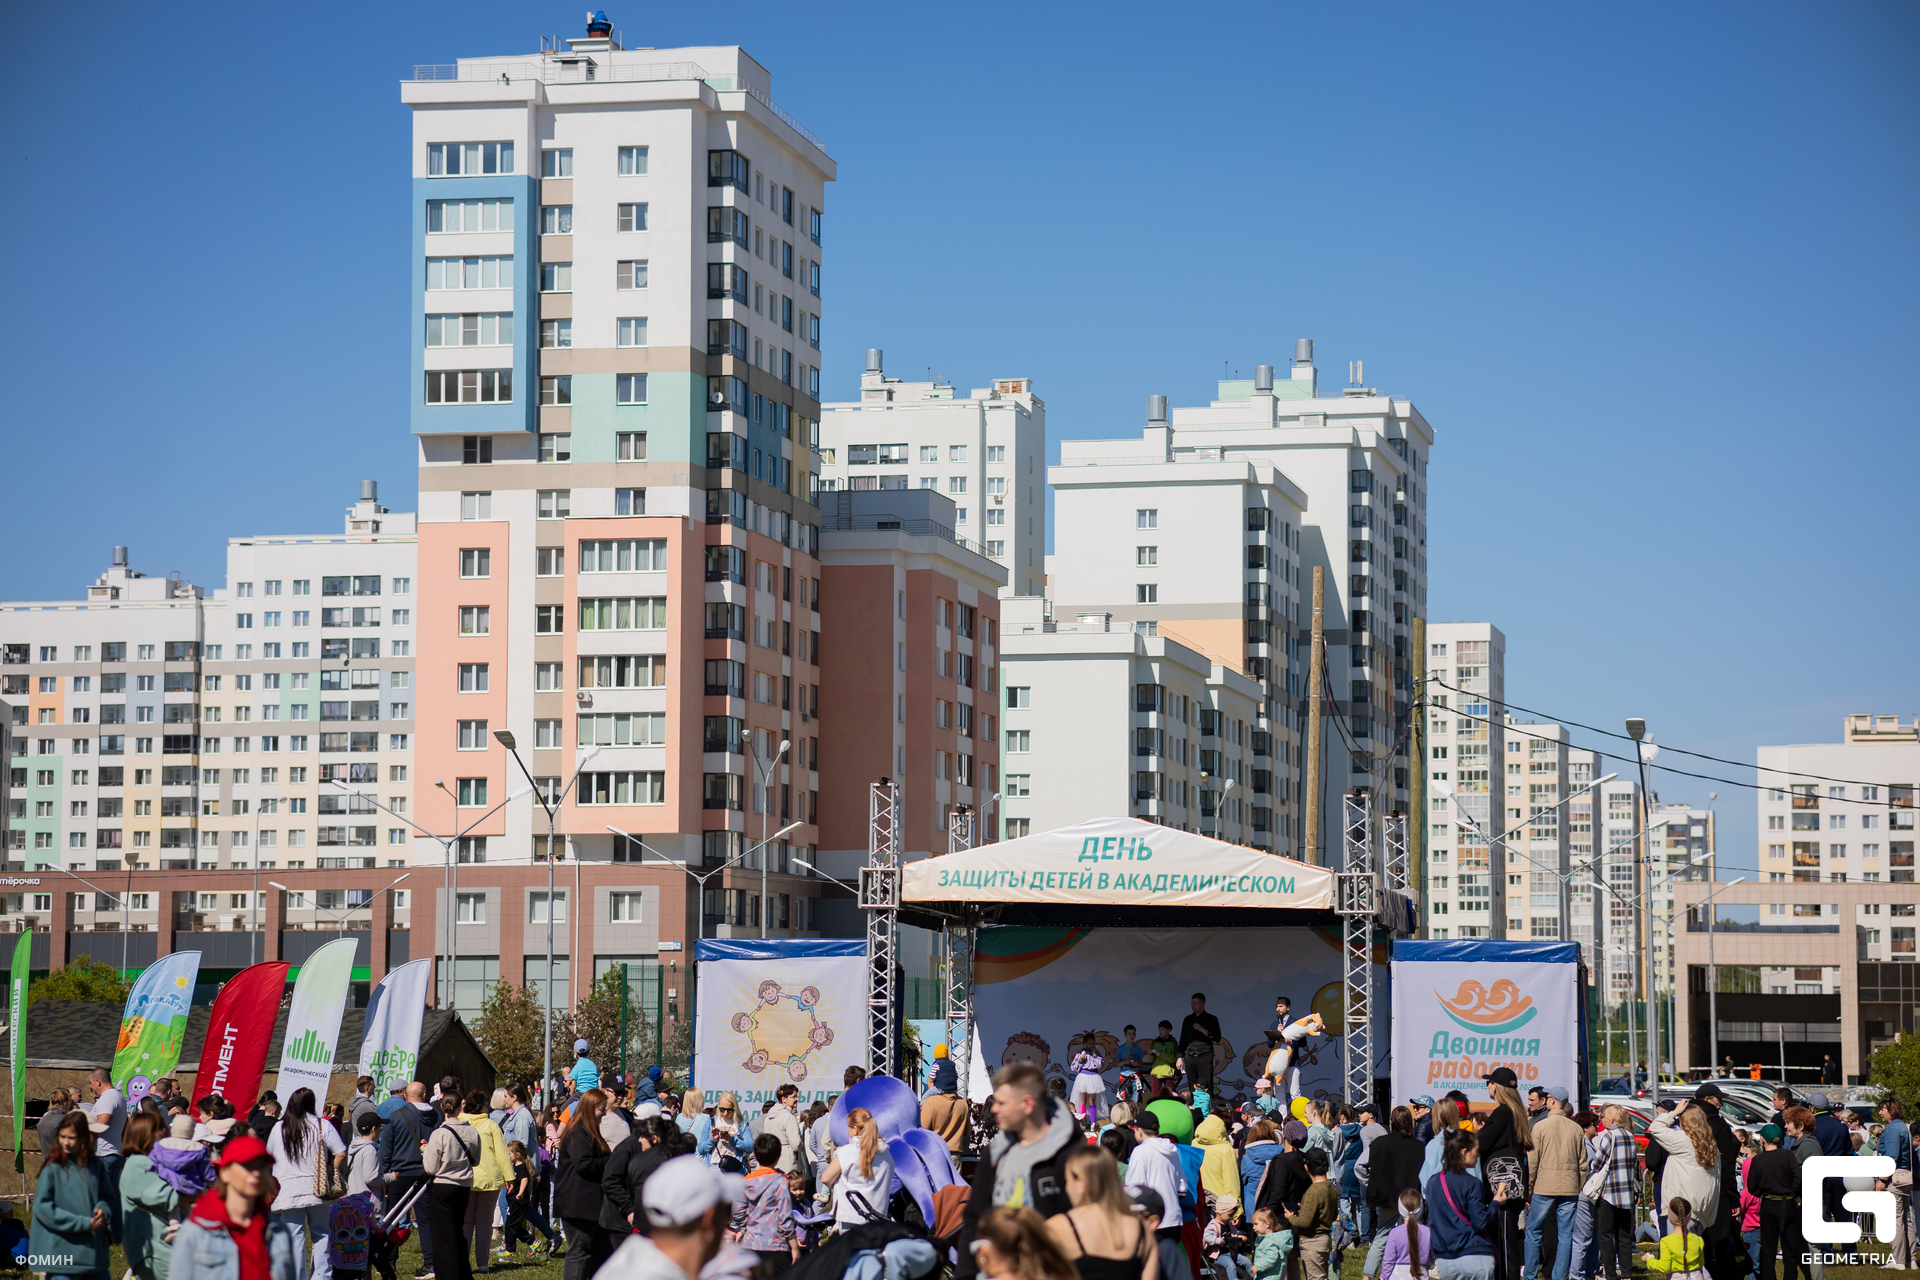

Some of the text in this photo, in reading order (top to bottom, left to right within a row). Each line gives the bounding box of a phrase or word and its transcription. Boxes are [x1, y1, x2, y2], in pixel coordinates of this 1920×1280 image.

[1078, 836, 1153, 863] ДЕНЬ
[938, 867, 1295, 894] ЗАЩИТЫ ДЕТЕЙ В АКАДЕМИЧЕСКОМ
[369, 1049, 416, 1070] ДОБРО
[1440, 1082, 1487, 1090] АКАДЕМИЧЕ
[704, 1090, 742, 1104] ДЕЬ
